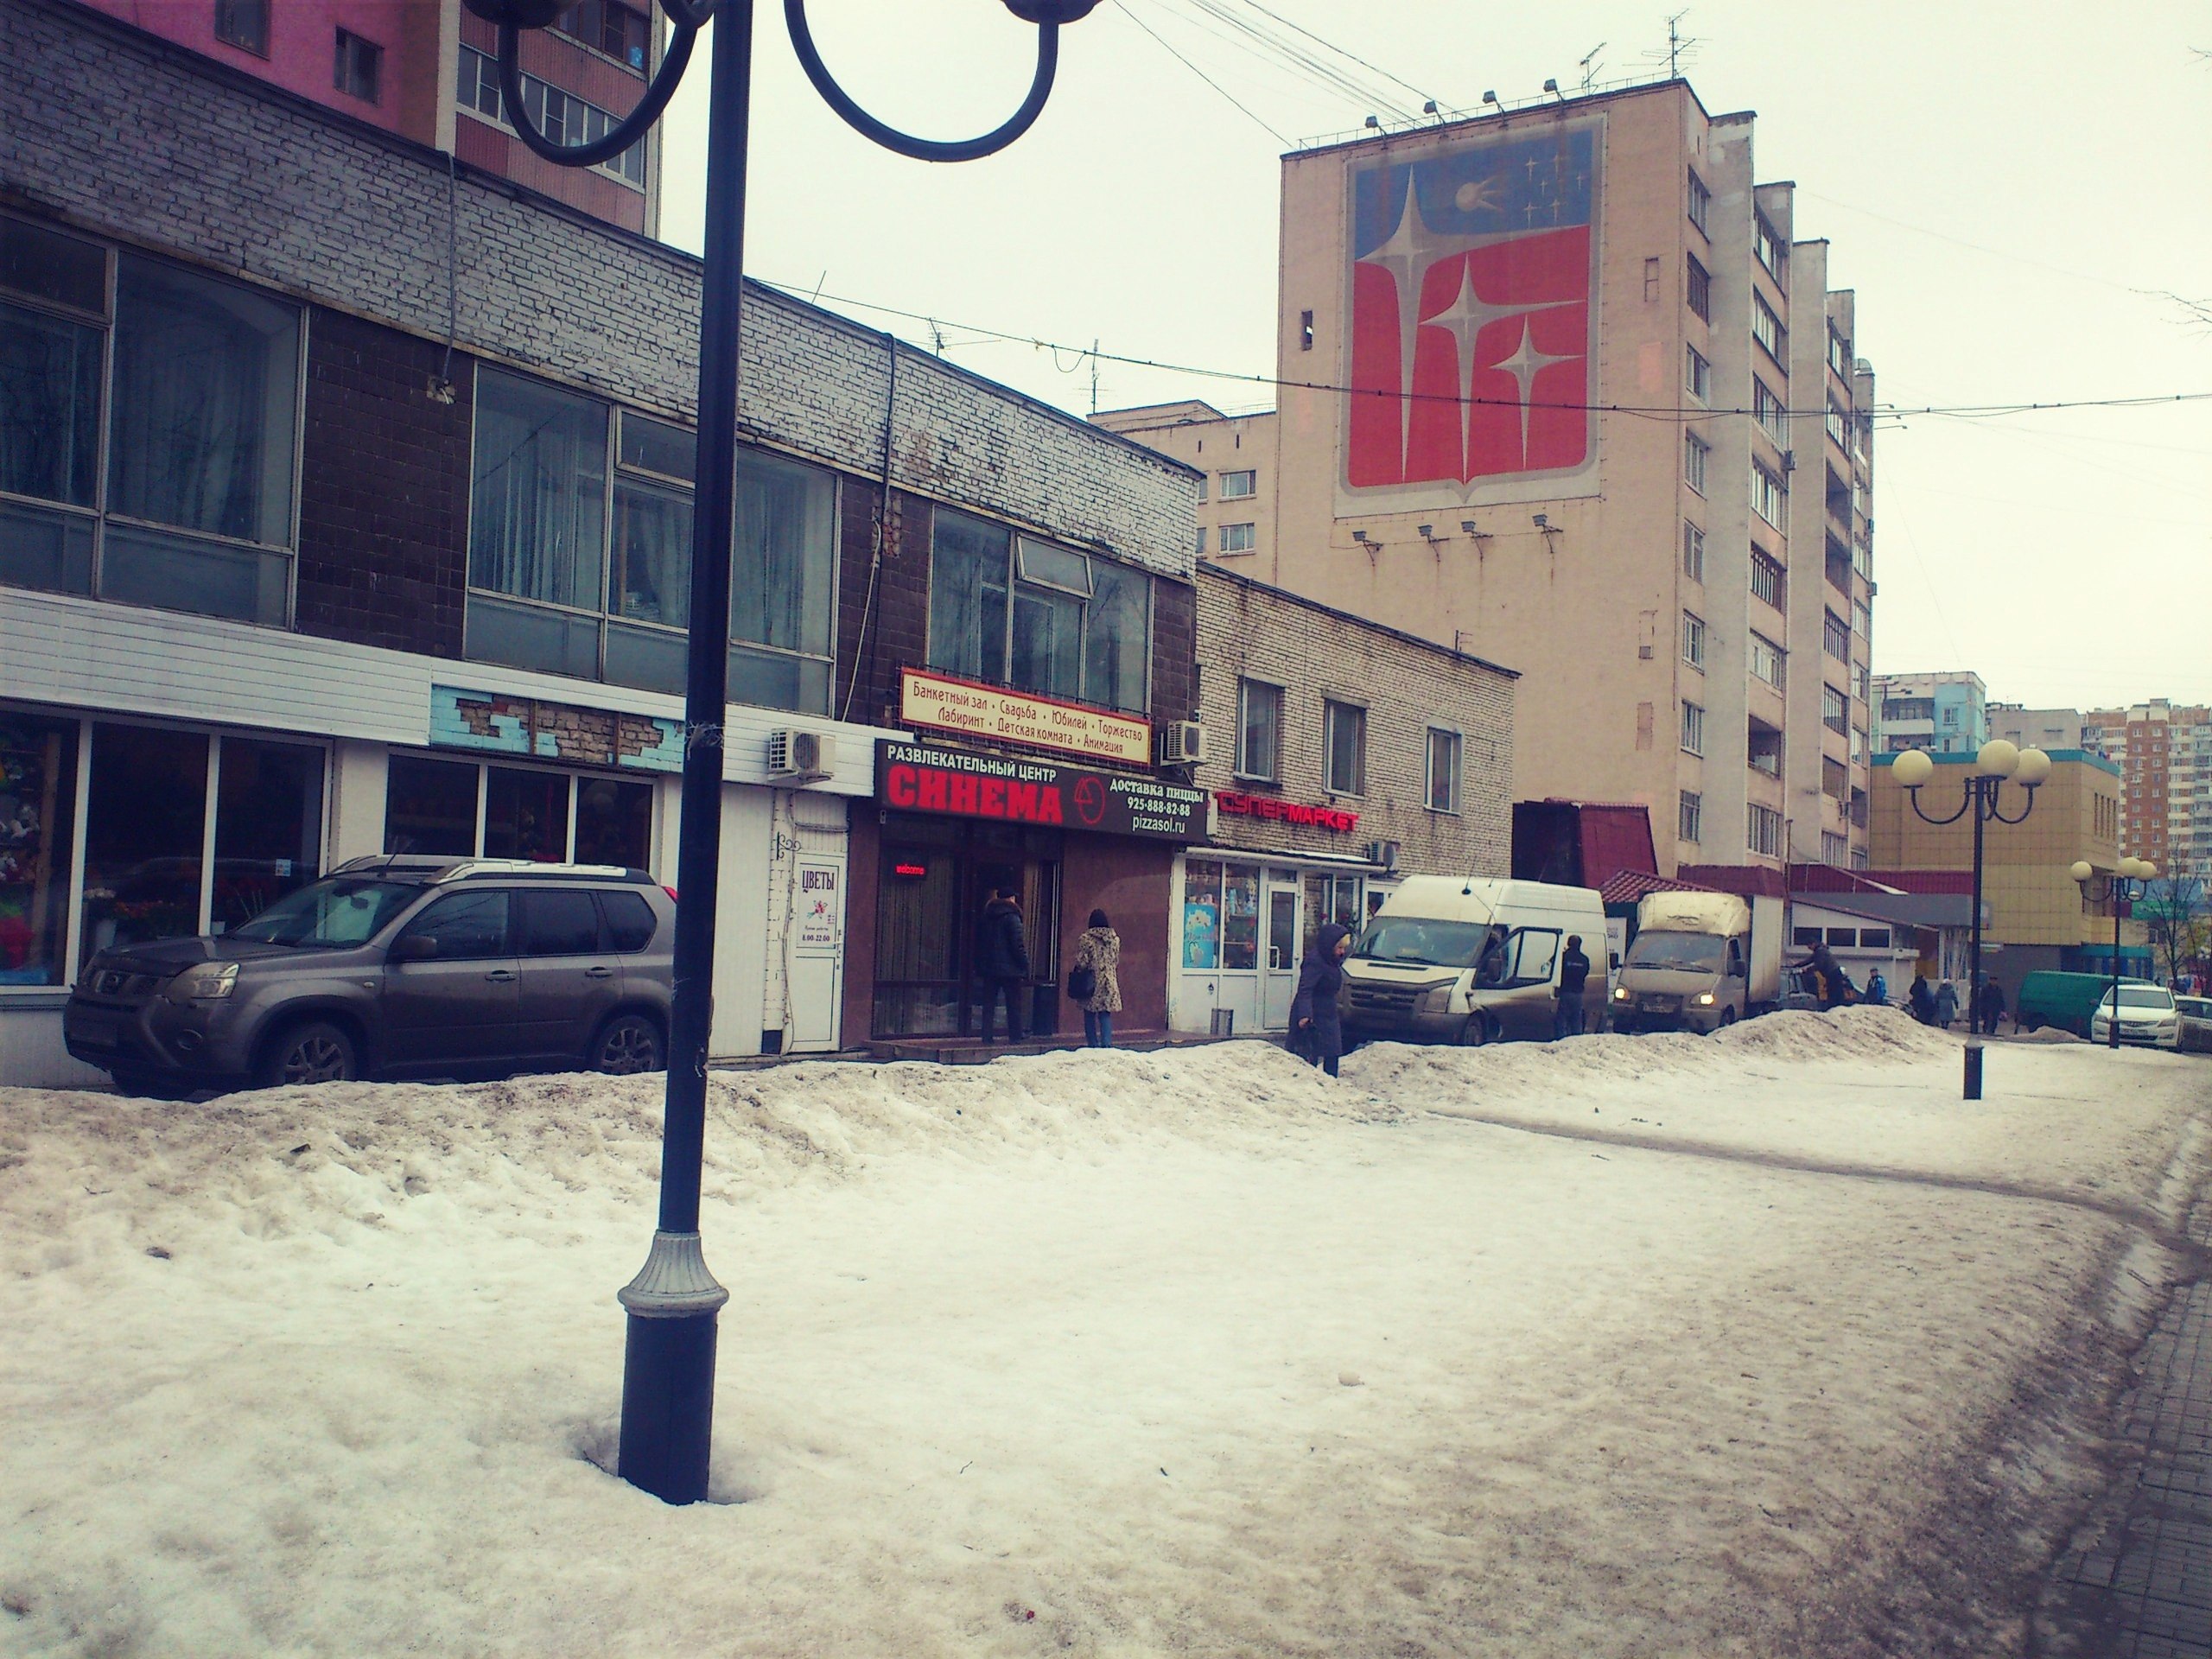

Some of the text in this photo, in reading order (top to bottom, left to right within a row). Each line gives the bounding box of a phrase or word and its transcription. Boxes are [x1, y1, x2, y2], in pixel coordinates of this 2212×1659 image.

[913, 681, 1142, 741] Банкетный зал Свадьба Юбилей Торжество
[938, 707, 1123, 754] Лабиринт Детская комната Анимация
[887, 744, 1057, 783] РАЗВЛЕКАТЕЛЬНЫЙ ЦЕНТР
[887, 764, 1064, 825] СИНЕМА
[1166, 786, 1204, 804] пиццы
[1214, 791, 1359, 831] СУПЕРМАРКЕТ
[1132, 813, 1185, 834] pizzasol.ru
[802, 870, 835, 893] ЦВЕТЫ
